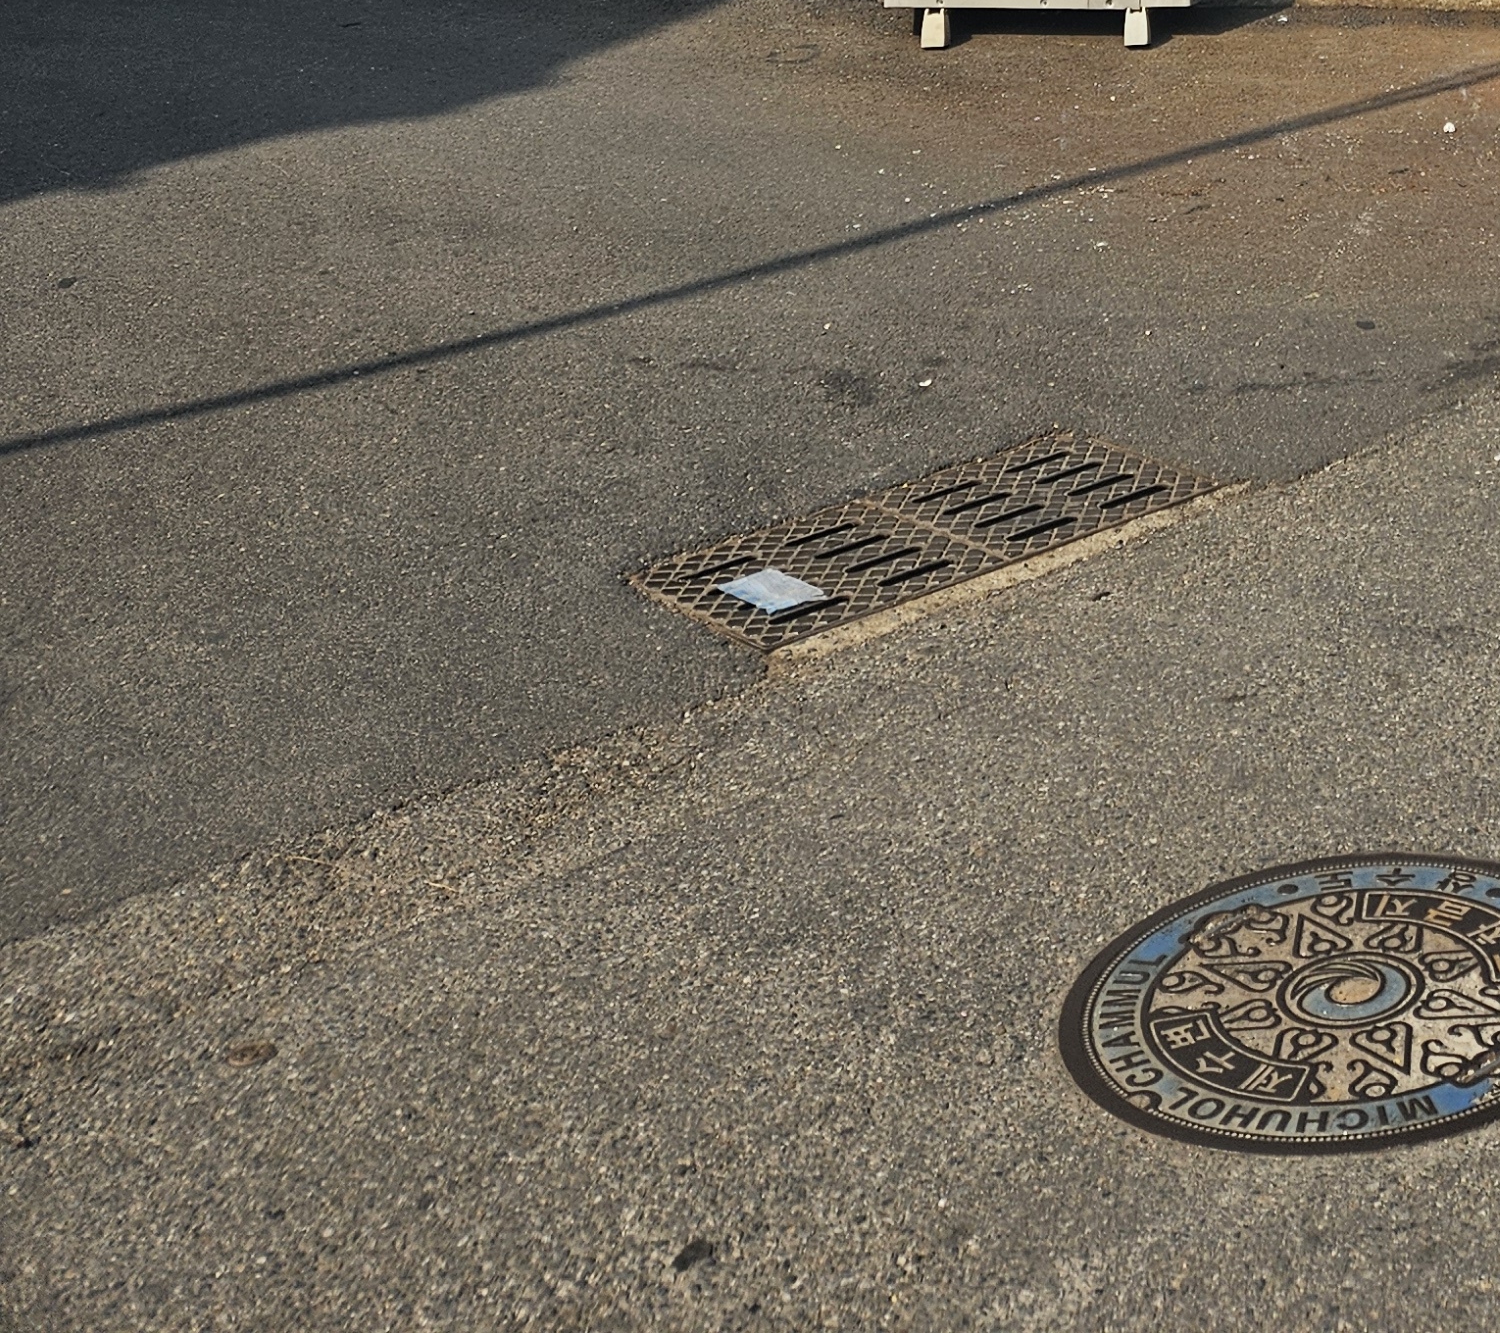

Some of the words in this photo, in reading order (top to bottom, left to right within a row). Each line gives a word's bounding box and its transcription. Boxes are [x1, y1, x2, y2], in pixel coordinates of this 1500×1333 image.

[1313, 867, 1477, 893] 상수도
[1098, 953, 1169, 1087] CHAMMUL
[1160, 1019, 1293, 1094] 제수변
[1168, 1085, 1439, 1134] MICHUHOL
